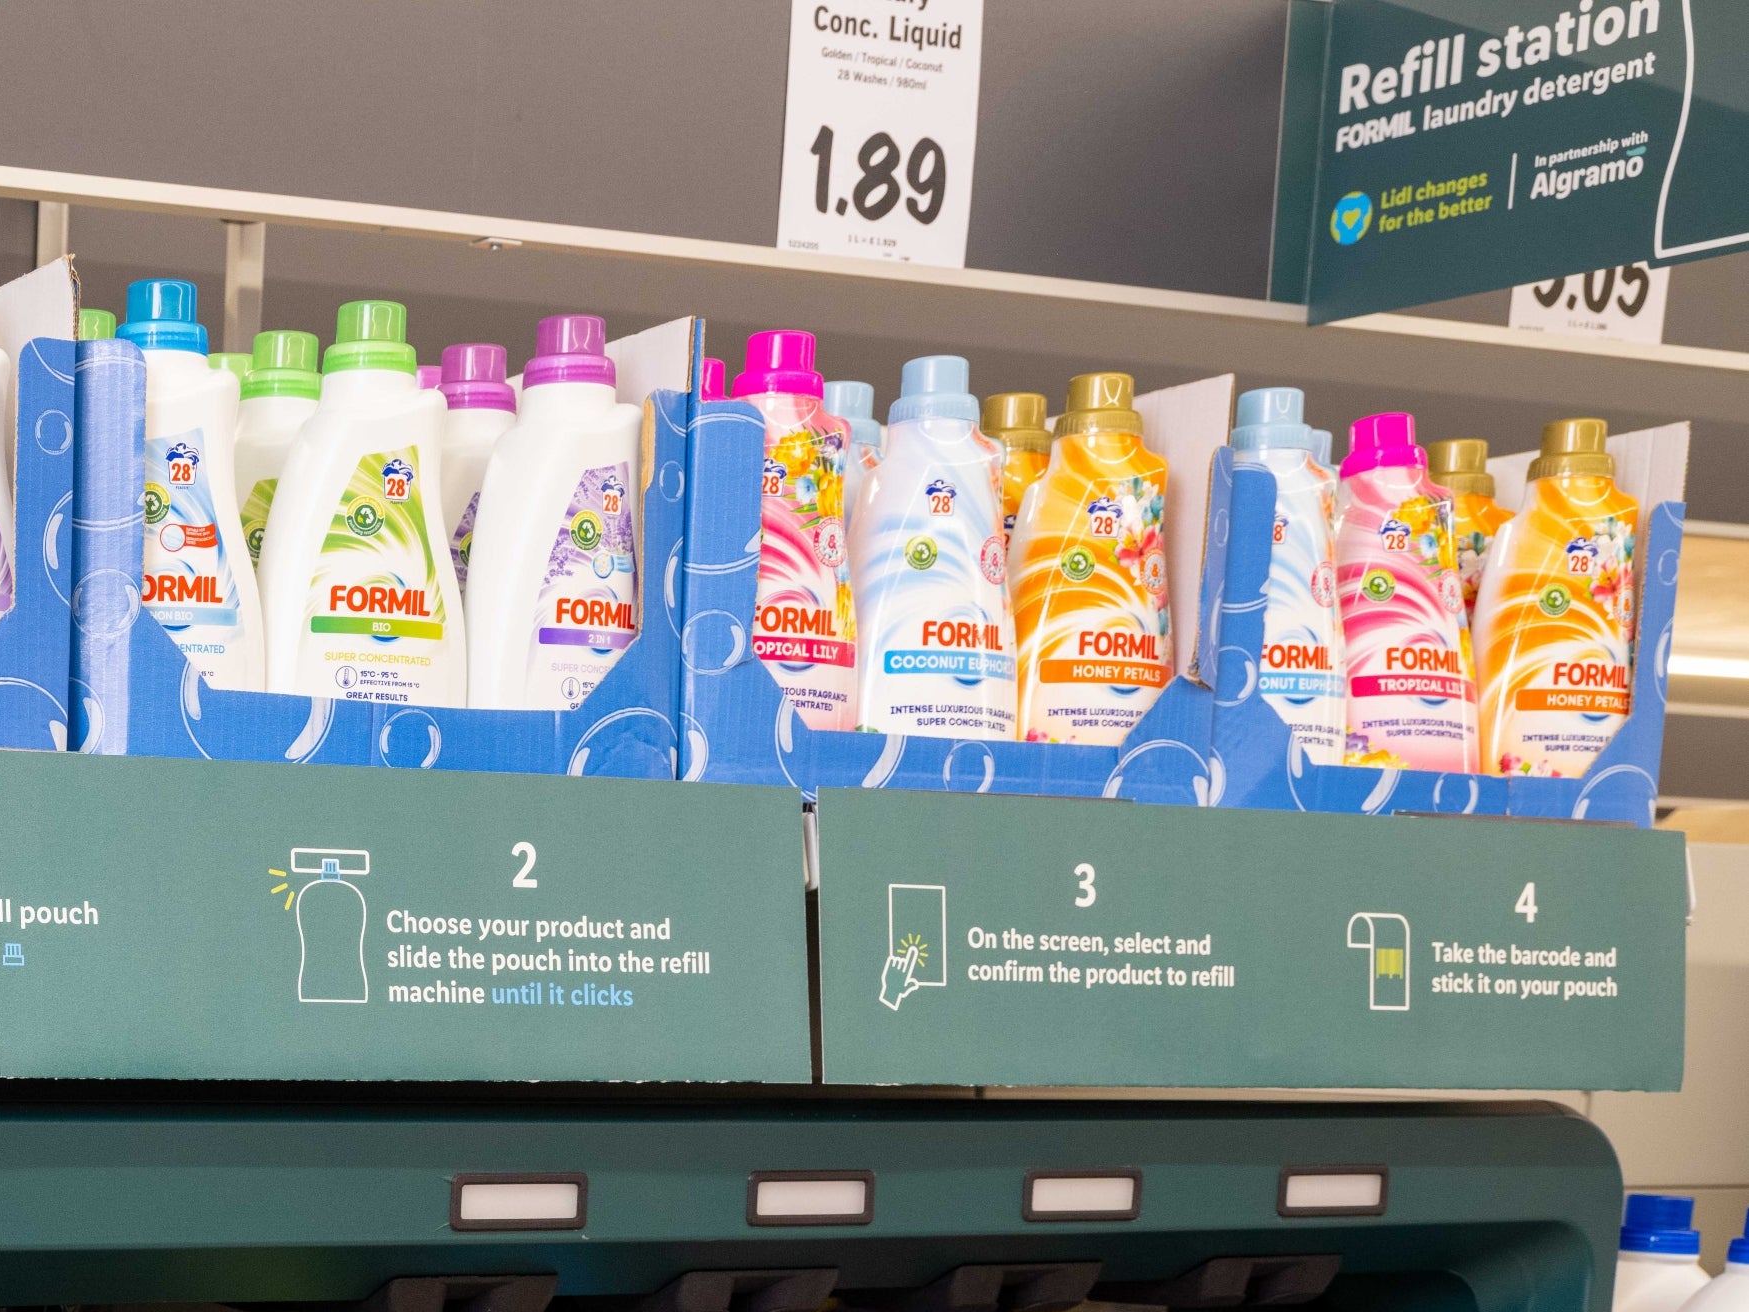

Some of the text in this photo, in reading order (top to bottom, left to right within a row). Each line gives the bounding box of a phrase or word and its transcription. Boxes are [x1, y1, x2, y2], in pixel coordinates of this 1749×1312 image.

[814, 6, 962, 51] Conc. Liquid
[1339, 0, 1659, 114] Refill station
[1336, 52, 1656, 152] FORMIL laundry detergent
[1535, 131, 1649, 167] In partnership with
[811, 125, 946, 225] 1.89
[1380, 172, 1488, 209] Lidl changes
[1379, 195, 1493, 233] for the better
[1079, 632, 1159, 661] FORMIL
[1073, 664, 1162, 682] HONEY PETALS
[512, 842, 537, 888] 2
[1074, 863, 1096, 907] 3
[21, 901, 98, 929] pouch
[1515, 883, 1538, 922] 4
[387, 910, 670, 942] Choose your product and
[968, 927, 1210, 955] On the screen, select and
[388, 945, 709, 975] slide the pouch into the refill
[1432, 942, 1616, 967] Take the barcode and
[968, 960, 1234, 988] confirm the product to refill
[1432, 972, 1617, 1000] stick it on your pouch
[389, 980, 633, 1006] machine until it clicks
